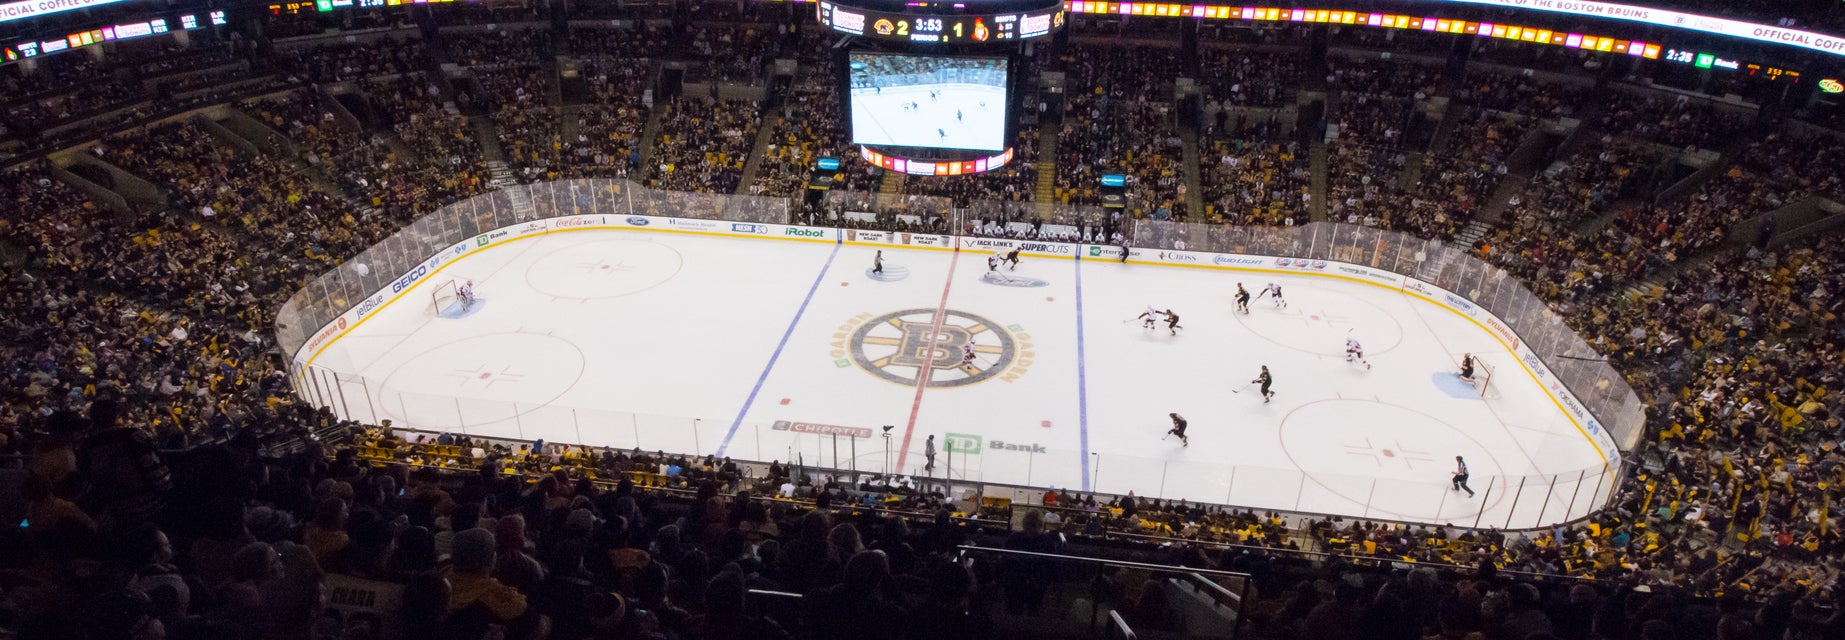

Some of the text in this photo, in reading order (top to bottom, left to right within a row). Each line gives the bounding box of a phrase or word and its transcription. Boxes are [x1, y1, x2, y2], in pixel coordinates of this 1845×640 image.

[0, 5, 36, 18] ICIAL
[1557, 1, 1604, 13] BOSTON
[1608, 7, 1649, 19] BRUINS
[897, 20, 908, 36] 2
[915, 19, 942, 31] 3:53
[953, 22, 963, 37] 1
[911, 34, 939, 42] PERIOD
[1753, 28, 1810, 45] OFFICIAL
[1666, 49, 1693, 63] 2:35
[630, 217, 646, 225] Ford
[490, 230, 508, 240] Bank
[785, 227, 825, 238] iRobot
[1021, 242, 1069, 253] SUPERCUTS
[392, 265, 427, 293] GEICO
[355, 295, 384, 320] jetBlue
[1487, 318, 1514, 343] SYLVANIA
[308, 325, 338, 352] SYLVANIA
[1522, 353, 1546, 378] jetBlue
[1558, 390, 1584, 420] YOKOHAMA
[794, 423, 870, 437] CHIPOTLE
[989, 439, 1047, 454] Bank
